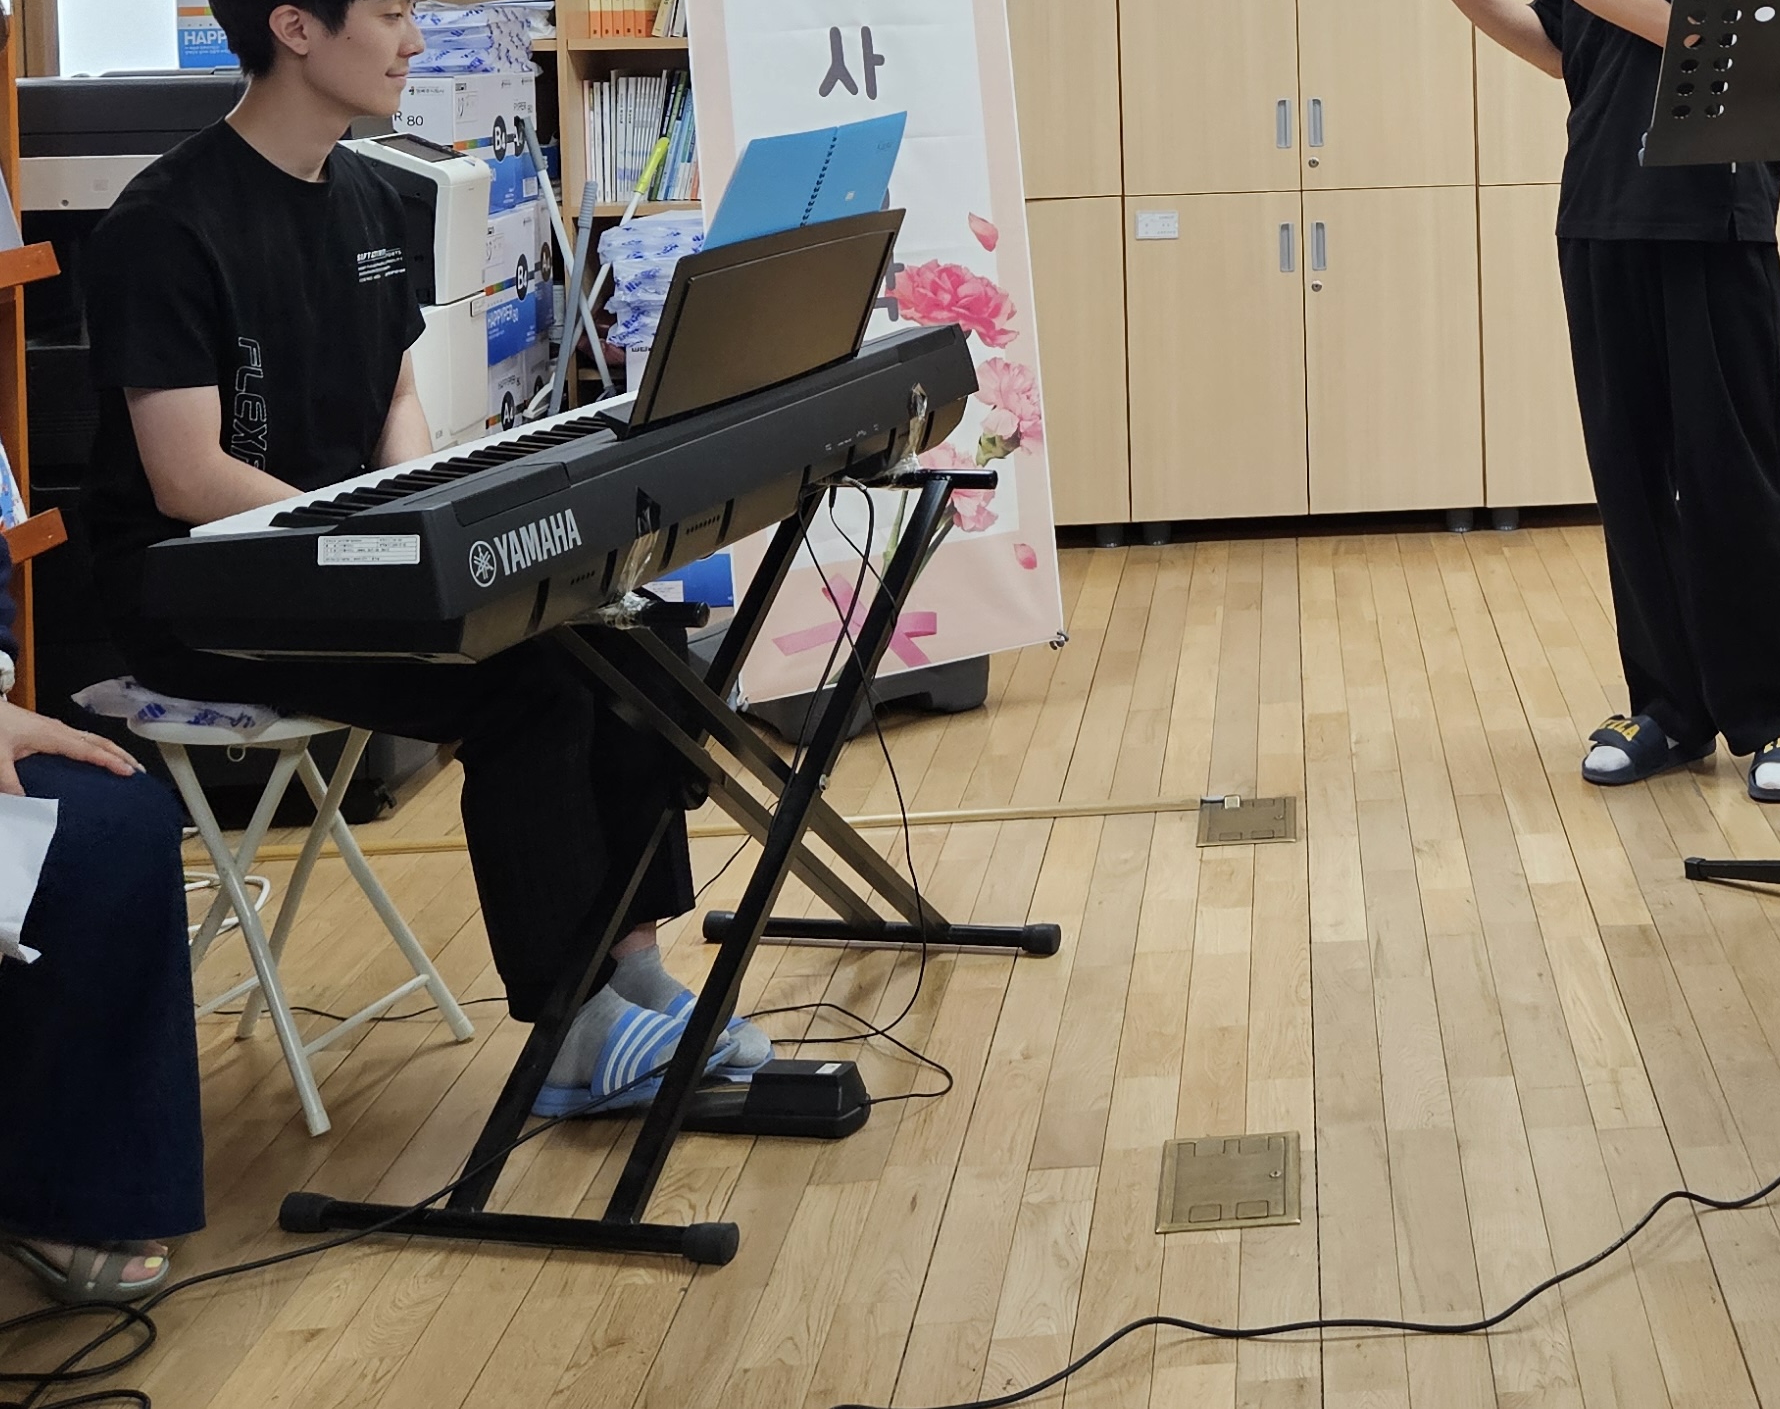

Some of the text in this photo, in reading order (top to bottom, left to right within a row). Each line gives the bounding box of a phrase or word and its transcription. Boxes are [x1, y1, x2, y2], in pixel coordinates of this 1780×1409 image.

[184, 31, 227, 45] HAPP
[406, 116, 424, 127] 80
[493, 508, 582, 576] YAMAHA
